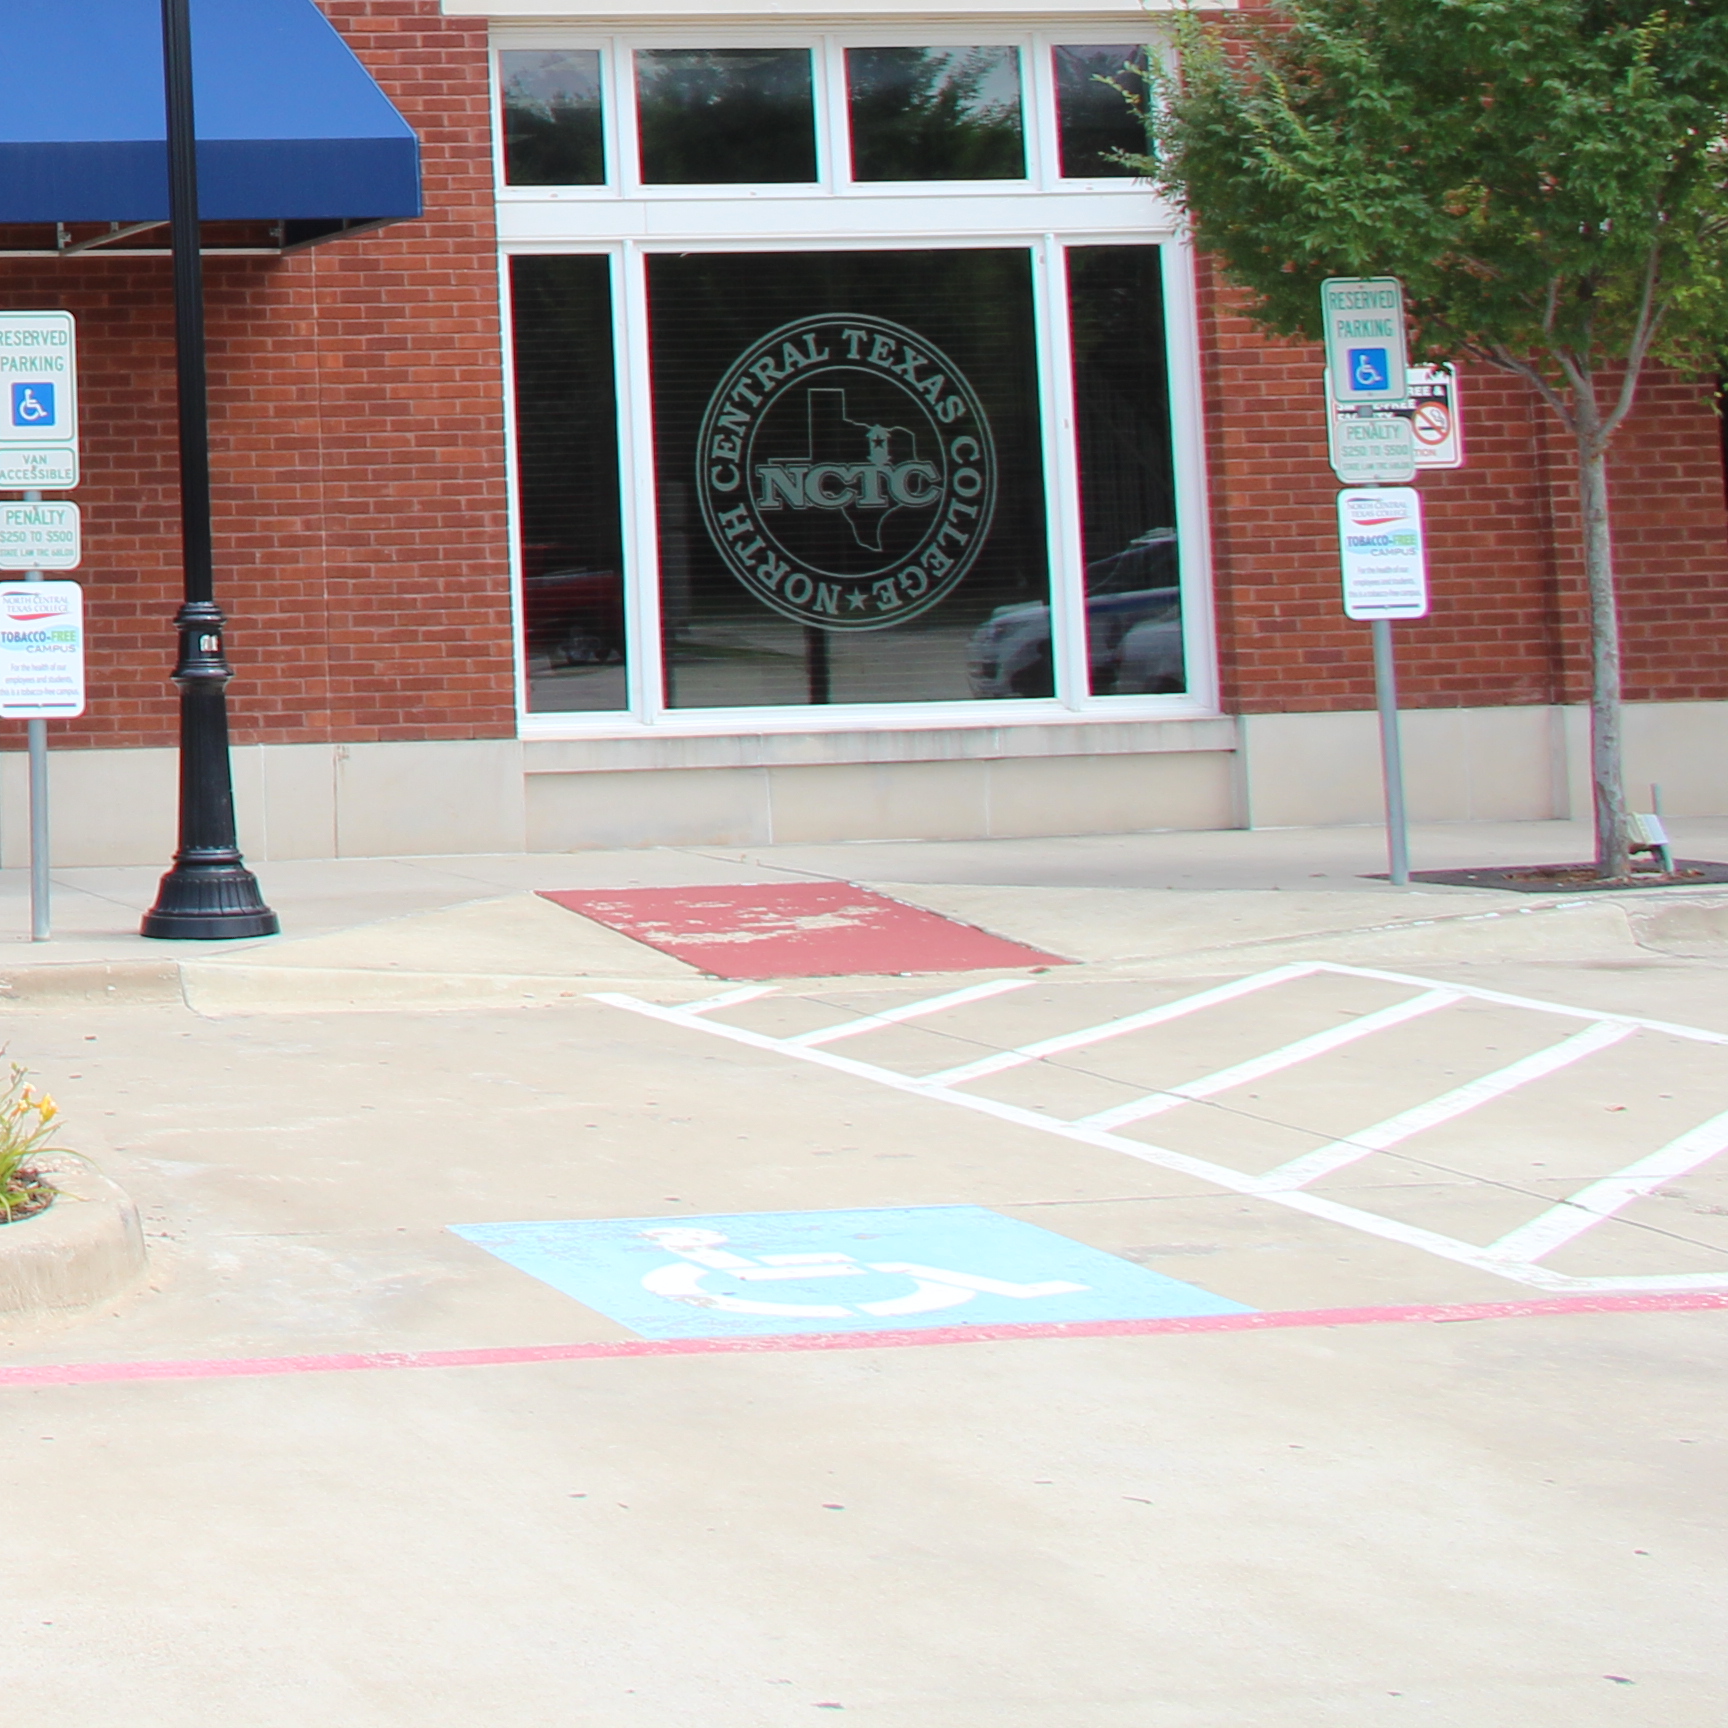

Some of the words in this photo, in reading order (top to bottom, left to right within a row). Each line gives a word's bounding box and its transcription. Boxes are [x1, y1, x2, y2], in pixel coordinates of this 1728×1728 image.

[1328, 290, 1395, 310] RESERVED
[1336, 318, 1393, 338] PARKING
[0, 355, 65, 373] PARKING
[842, 328, 967, 423] TEXAS
[710, 332, 830, 492] CENTRAL
[1346, 424, 1401, 440] PENALTY
[22, 454, 48, 465] VAN
[755, 460, 944, 510] NCTC
[5, 509, 66, 526] PENALTY
[872, 436, 983, 611] COLLEGE
[30, 530, 43, 543] TO
[45, 530, 74, 543] $500
[718, 502, 841, 615] NORTH
[1370, 547, 1417, 557] CAMPUS
[2, 596, 31, 604] NORTH
[33, 595, 69, 604] CENTRAL
[7, 605, 32, 613] TEXAS
[33, 604, 69, 613] COLLEGE
[0, 630, 77, 643] TOBACCO-FREE
[26, 644, 76, 654] CAMPUS
